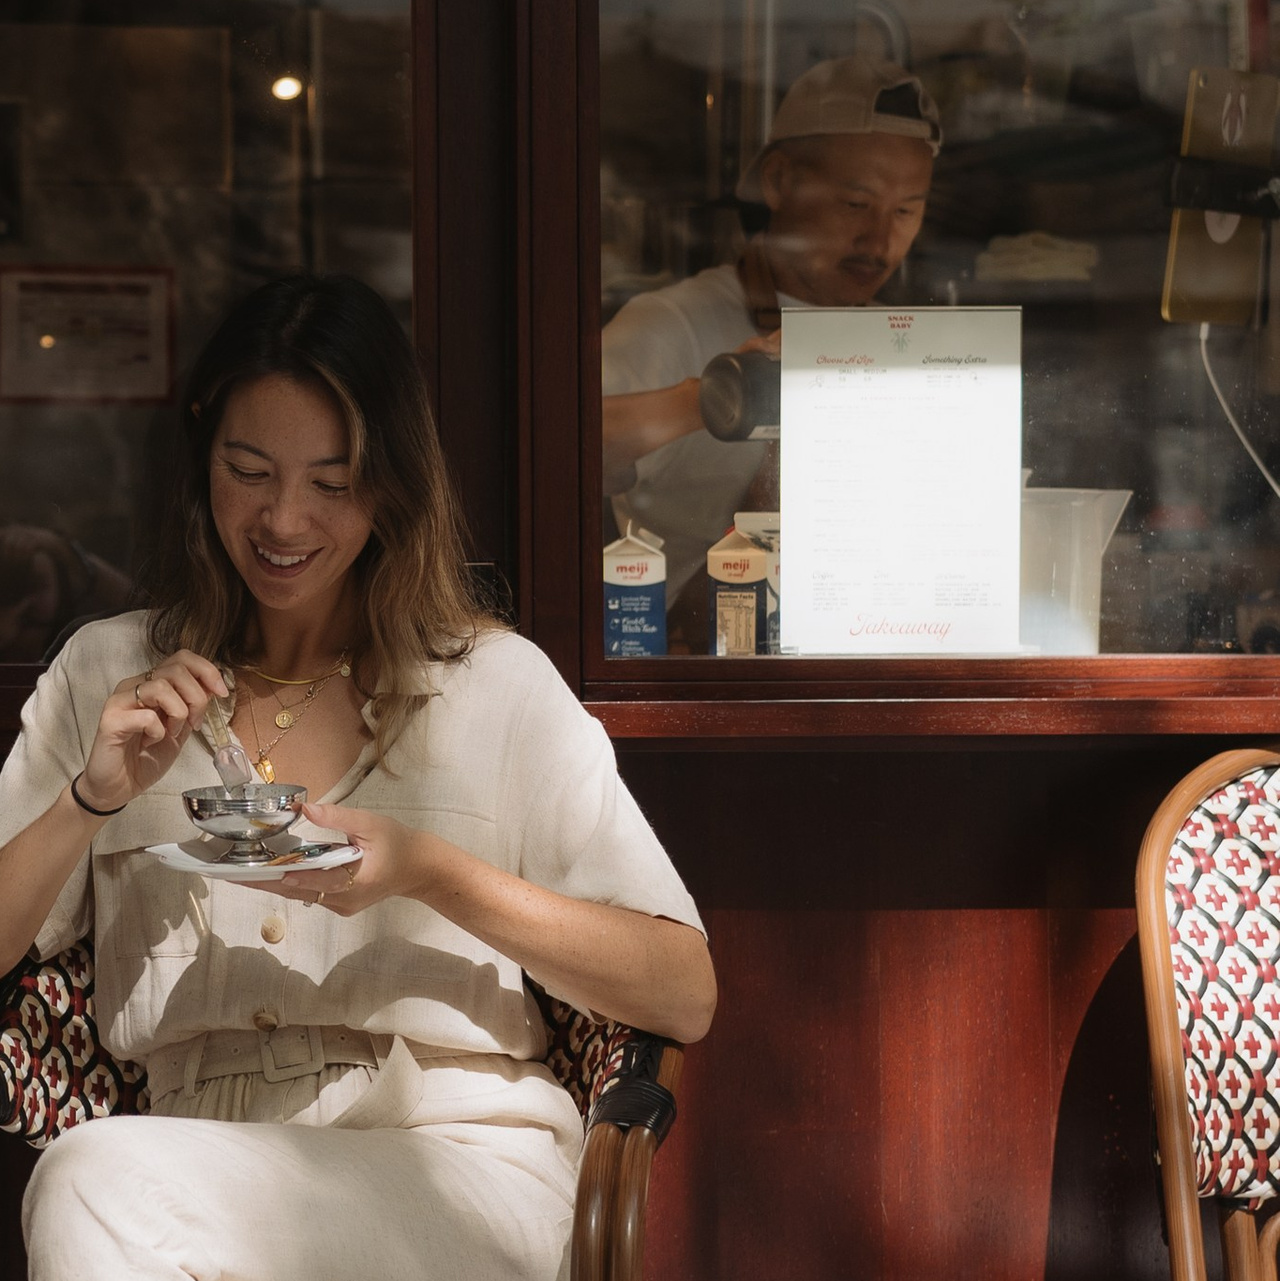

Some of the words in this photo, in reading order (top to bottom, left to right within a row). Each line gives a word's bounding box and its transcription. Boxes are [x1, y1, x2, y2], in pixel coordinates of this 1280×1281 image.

[816, 354, 844, 365] Choose
[856, 354, 875, 366] Size
[922, 354, 963, 366] Something
[963, 354, 988, 365] Extra
[616, 562, 649, 575] meiji
[722, 559, 750, 573] meiji
[849, 611, 952, 642] Takeaway
